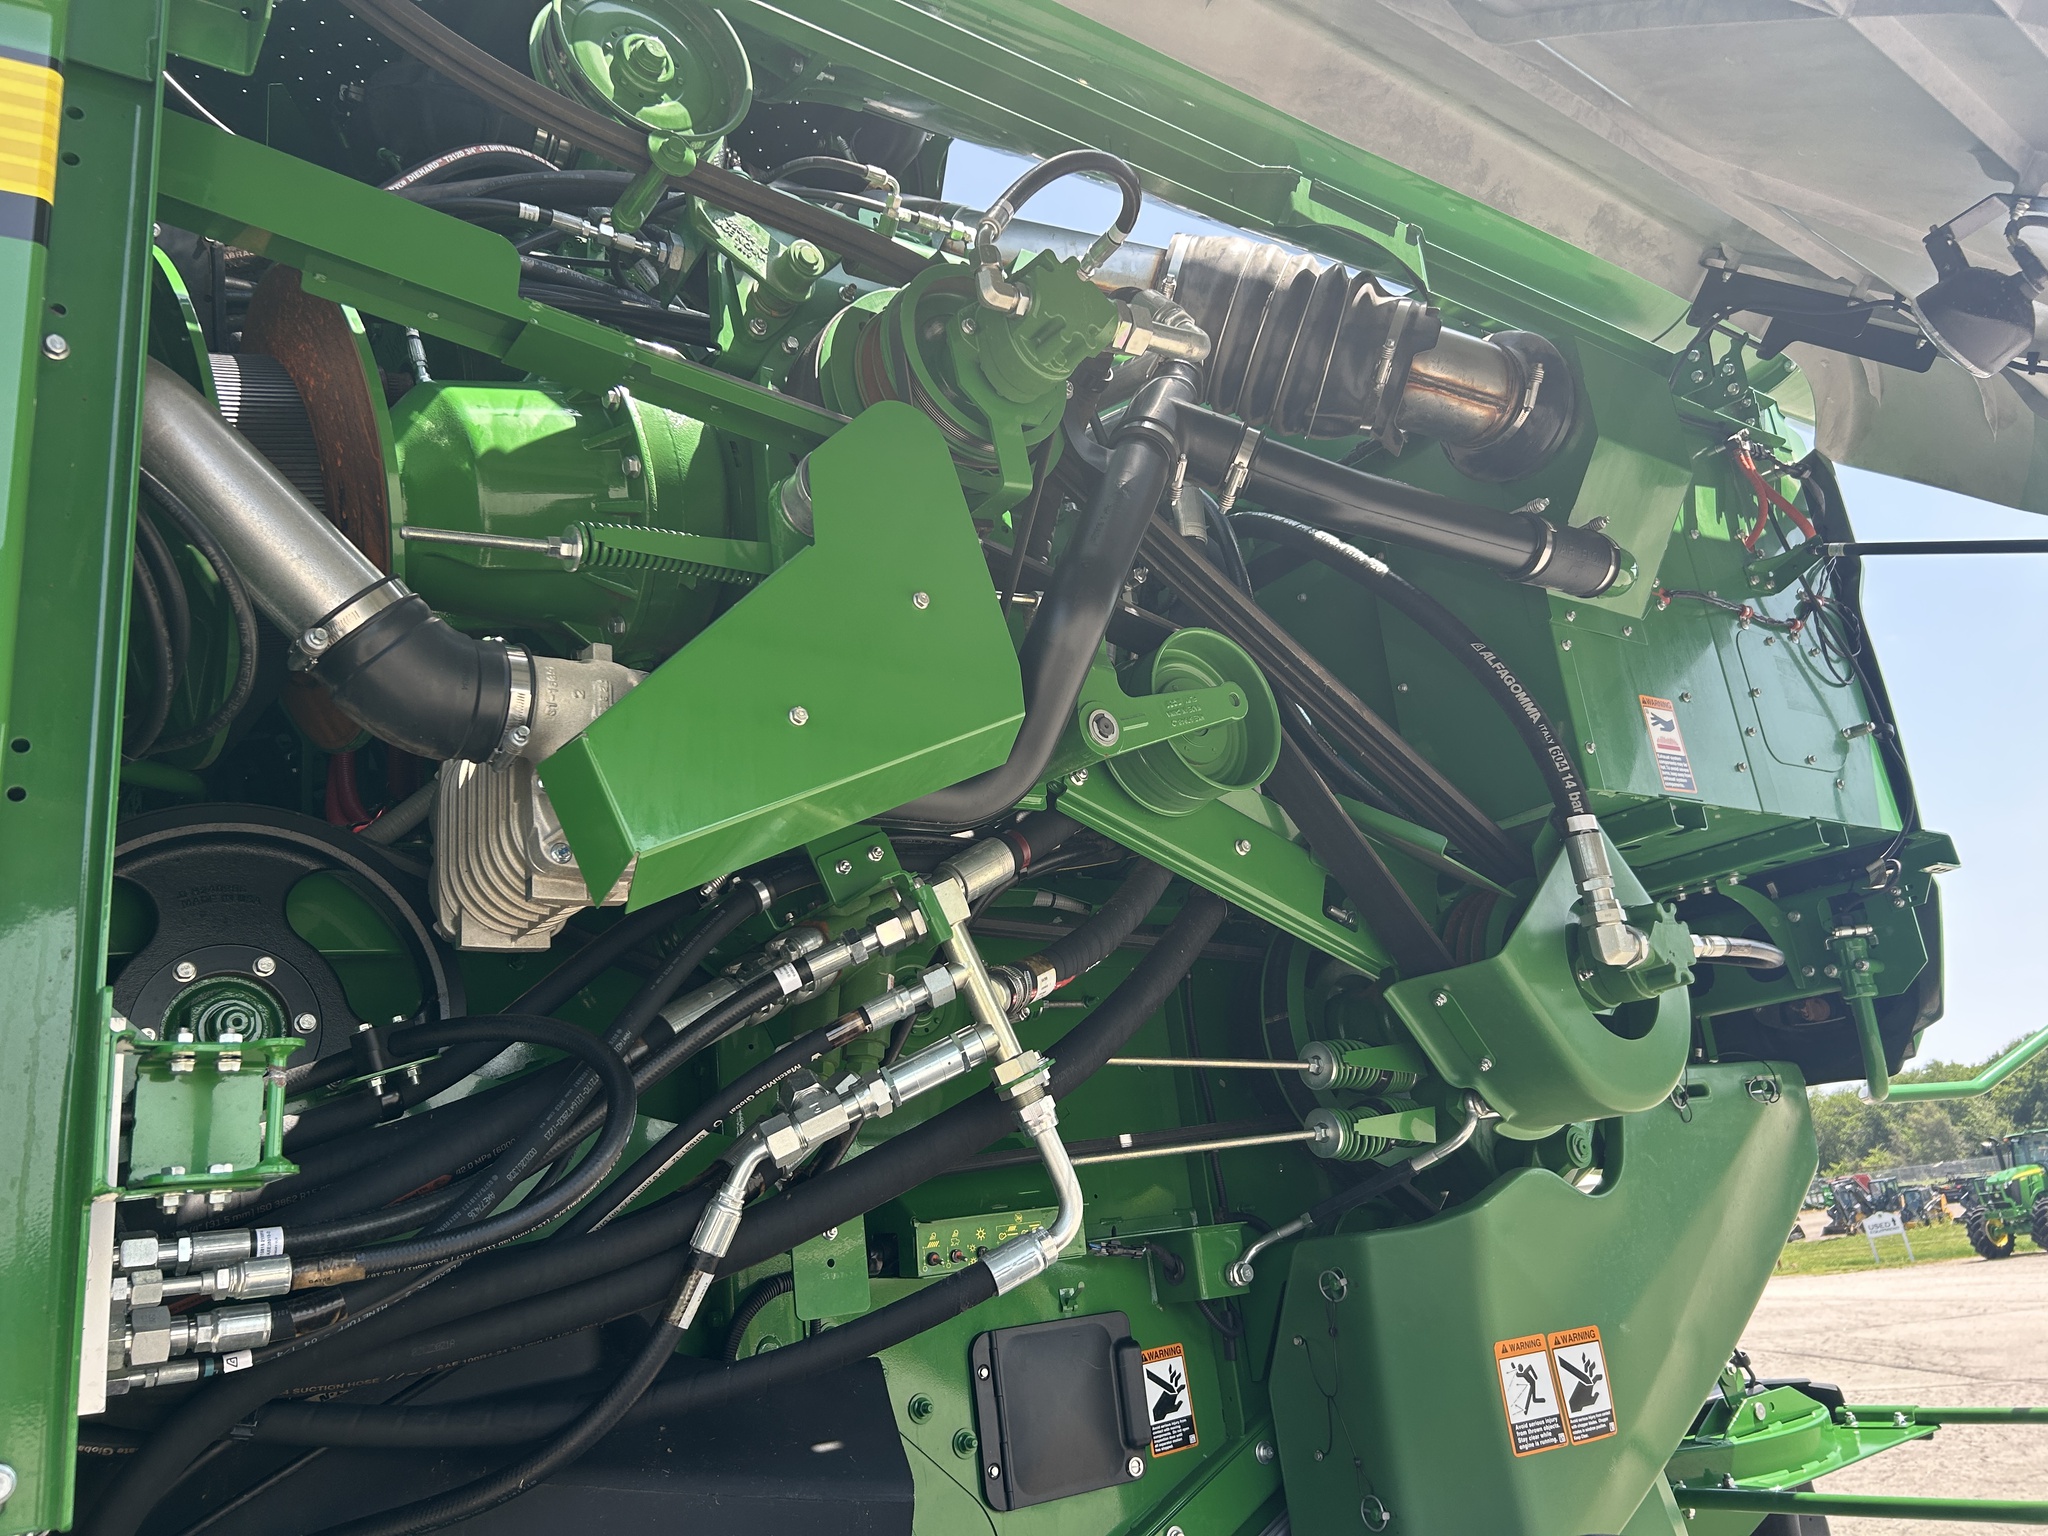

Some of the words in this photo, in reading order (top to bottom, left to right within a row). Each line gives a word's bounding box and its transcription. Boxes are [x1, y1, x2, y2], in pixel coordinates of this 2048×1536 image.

[1480, 651, 1542, 724] ALFAGOMMA
[1646, 698, 1672, 710] WARNING
[1538, 724, 1554, 744] ITALY
[1549, 746, 1570, 772] 604
[1562, 772, 1577, 789] 14
[1568, 791, 1584, 814] bar
[755, 1063, 802, 1095] MatchMate
[256, 1202, 272, 1214] ISO
[274, 1194, 298, 1209] 3862
[1868, 1222, 1891, 1230] USED
[1509, 1338, 1542, 1352] WARNING
[1560, 1330, 1596, 1344] WARNING
[1147, 1345, 1182, 1361] WARNING
[288, 1382, 345, 1395] SUCTION
[346, 1377, 380, 1388] HOSE
